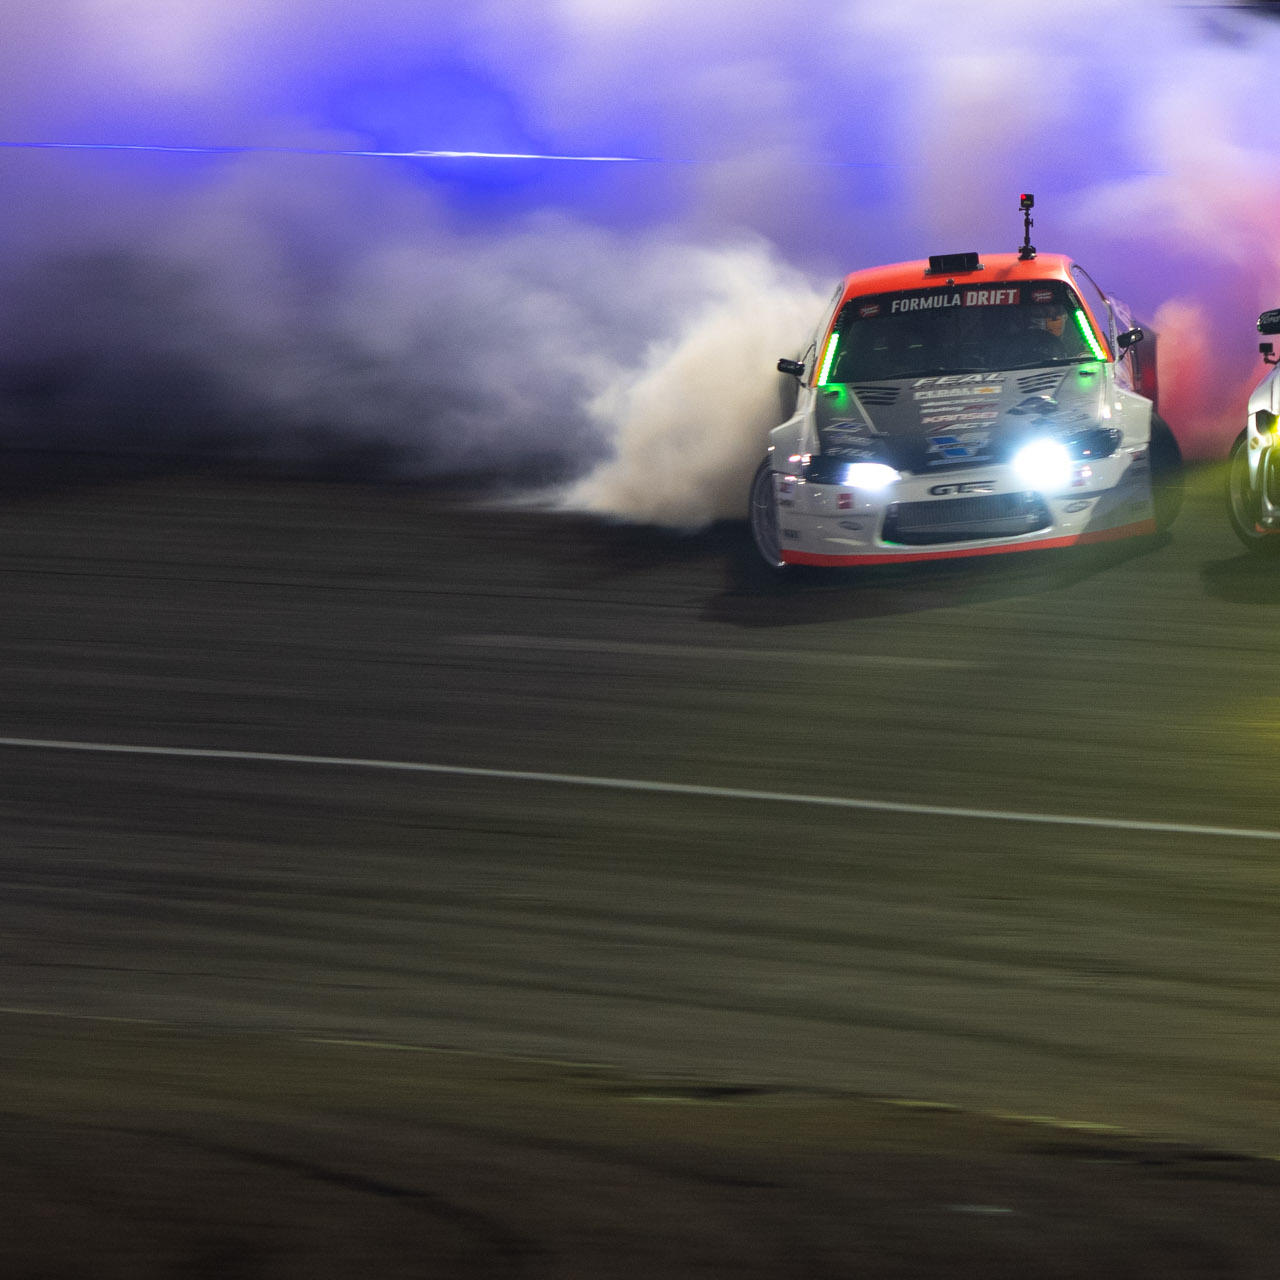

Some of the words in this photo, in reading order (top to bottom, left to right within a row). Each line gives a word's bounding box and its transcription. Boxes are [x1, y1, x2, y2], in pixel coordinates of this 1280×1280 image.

[891, 293, 961, 313] FORMULA
[966, 289, 1018, 306] DRIFT
[911, 373, 1005, 388] FEAL
